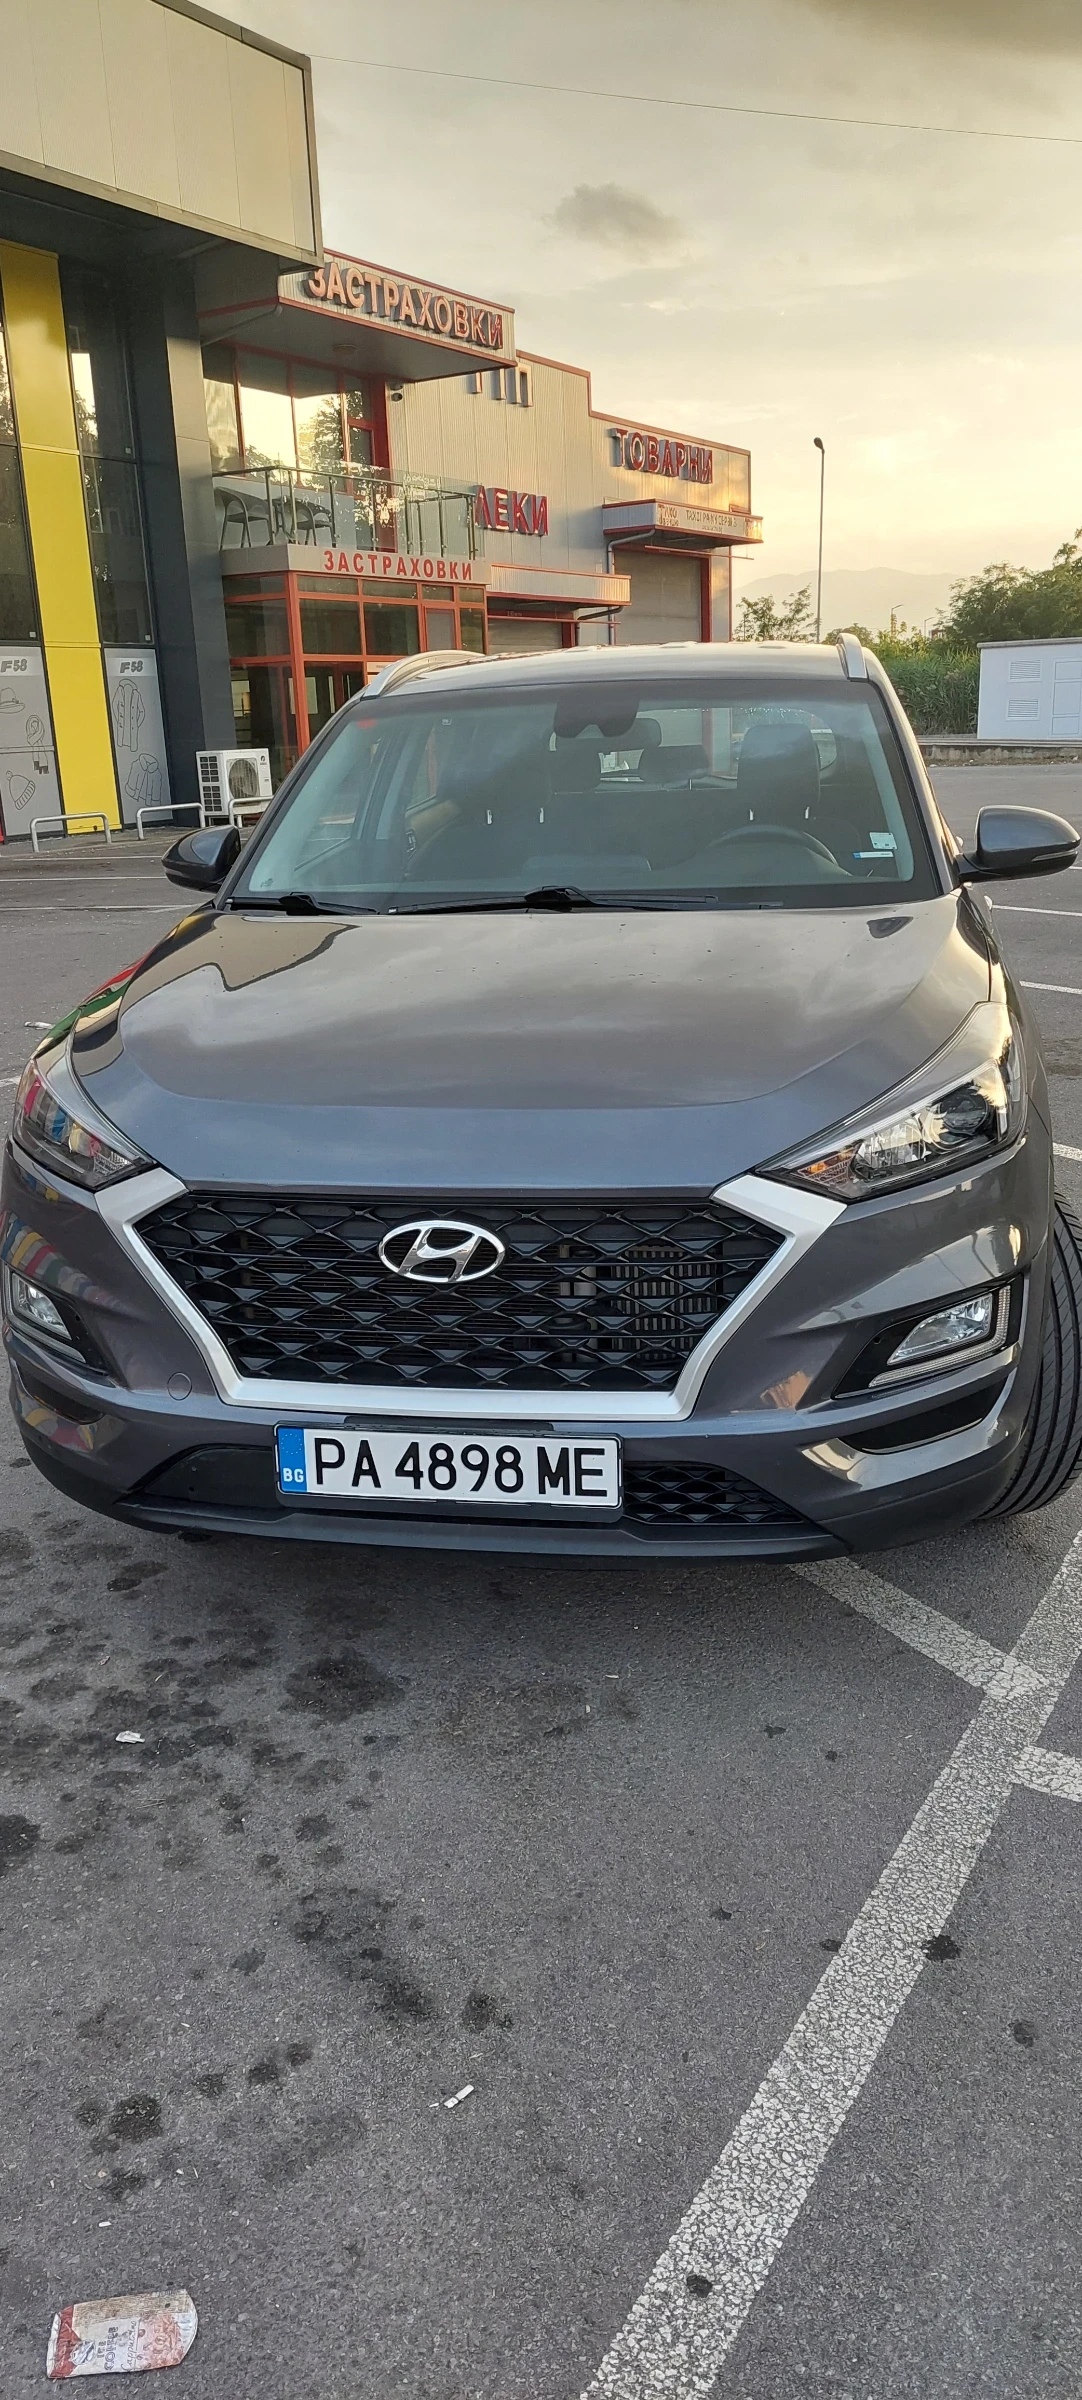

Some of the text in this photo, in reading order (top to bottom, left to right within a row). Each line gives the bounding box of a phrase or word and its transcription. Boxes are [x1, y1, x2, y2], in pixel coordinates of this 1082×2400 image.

[307, 261, 503, 349] ЗАСТРАХОВКИ
[614, 427, 713, 484] ТОВАРНИ
[474, 485, 549, 536] ЛЕКИ
[323, 550, 473, 581] ЗАСТРАХОВКИ
[283, 1467, 304, 1483] BG
[314, 1437, 608, 1498] PA 4898 ME
